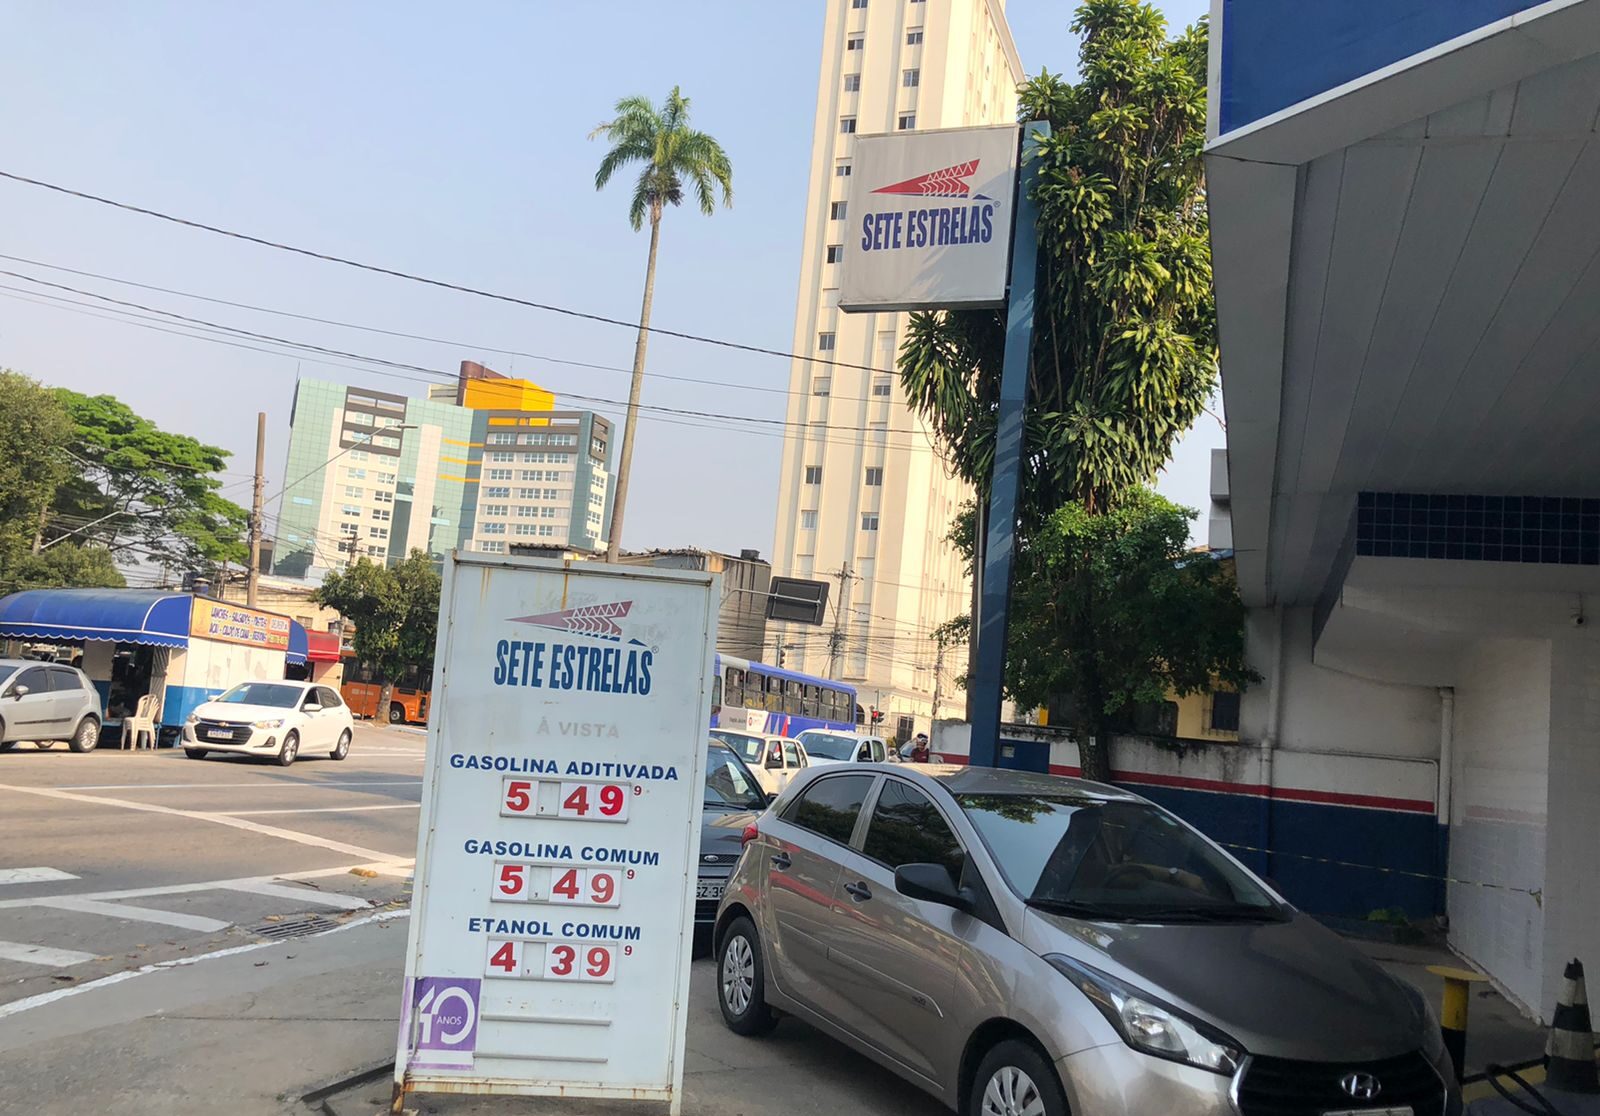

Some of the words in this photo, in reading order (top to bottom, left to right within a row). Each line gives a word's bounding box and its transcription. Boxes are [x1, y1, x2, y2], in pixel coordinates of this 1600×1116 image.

[862, 211, 902, 251] SETE
[907, 204, 993, 248] ESTRELAS
[494, 639, 544, 688] SETE
[549, 643, 653, 696] ESTRELAS
[558, 722, 620, 738] VISTA
[450, 754, 558, 774] GASOLINA
[565, 761, 678, 781] ADITIVADA
[464, 839, 573, 860] GASOLINA
[580, 846, 660, 866] COMUM
[468, 918, 553, 936] ETANOL
[561, 923, 641, 940] COMUM
[436, 1016, 462, 1026] ANOS
